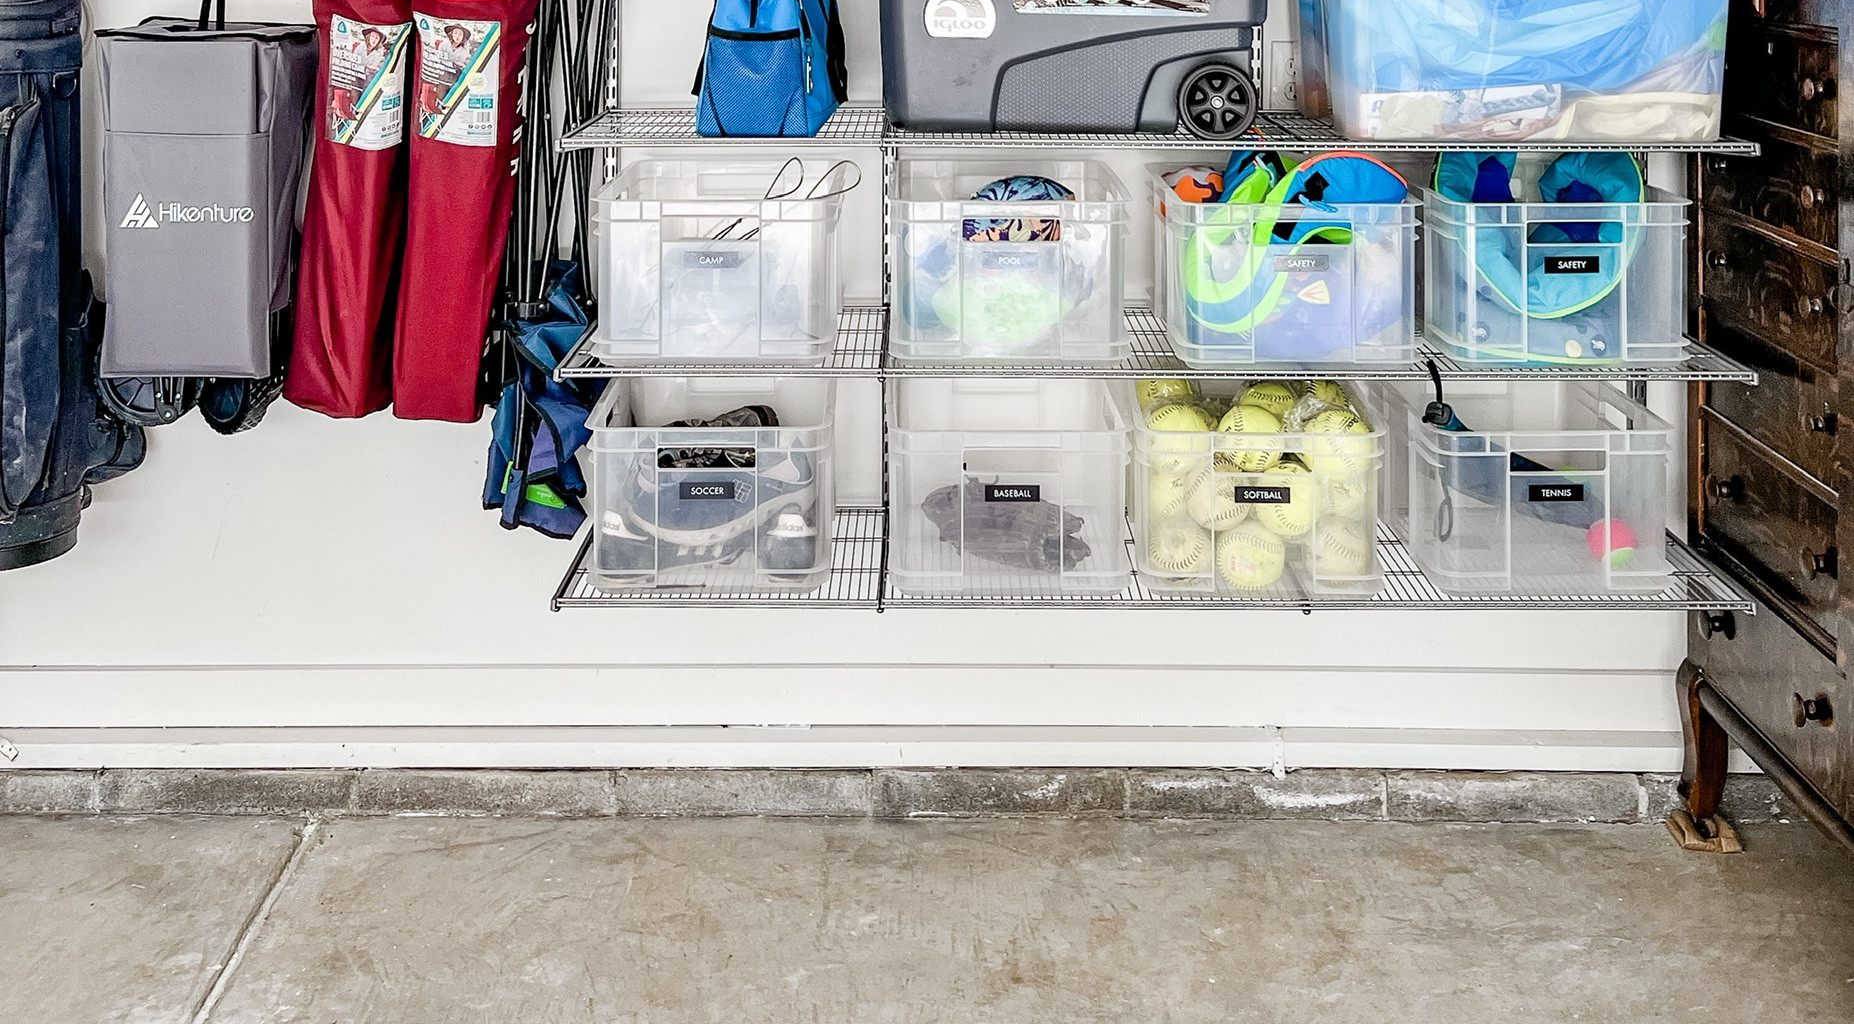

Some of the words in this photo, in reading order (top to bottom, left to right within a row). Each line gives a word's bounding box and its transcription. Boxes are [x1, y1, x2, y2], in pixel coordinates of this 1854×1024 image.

[933, 19, 987, 33] IGLOO
[159, 202, 254, 223] Hikenture
[699, 256, 724, 265] CAMP
[998, 256, 1020, 265] POOL
[1287, 259, 1316, 268] SAFETY
[1557, 260, 1587, 269] SAFETY
[690, 486, 725, 495] SOCCER
[993, 489, 1032, 498] BASEBALL
[1243, 490, 1282, 499] SOFTBALL
[1541, 488, 1572, 497] TENNIS
